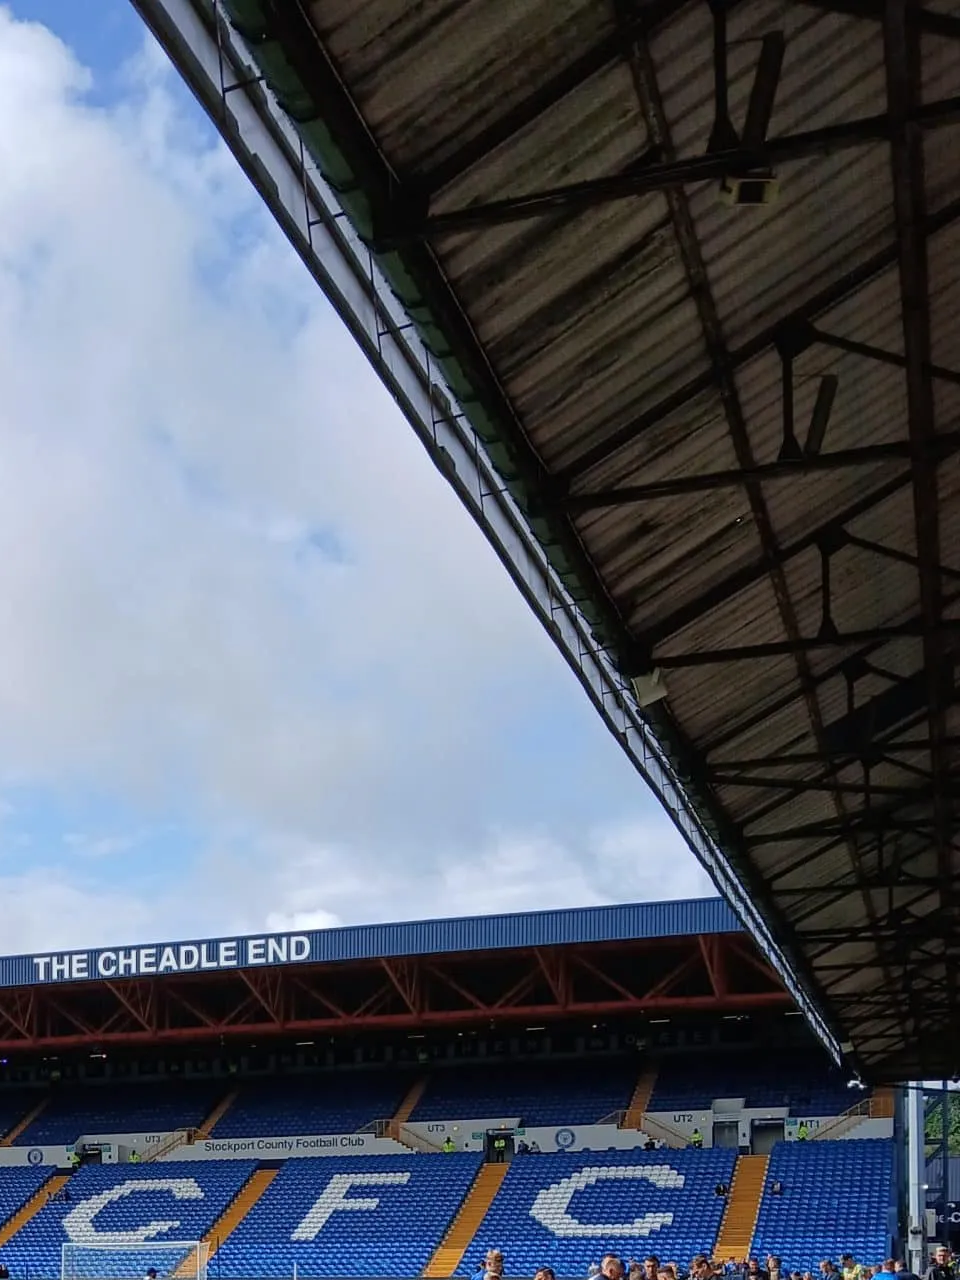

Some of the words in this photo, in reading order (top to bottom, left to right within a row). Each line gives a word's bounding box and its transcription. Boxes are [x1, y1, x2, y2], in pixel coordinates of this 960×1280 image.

[33, 953, 89, 981] THE
[97, 940, 237, 977] CHEADLE
[247, 935, 311, 965] END
[673, 1114, 693, 1123] UT2
[427, 1124, 446, 1133] UT3
[144, 1135, 161, 1144] UT3
[204, 1139, 255, 1153] Stockport
[257, 1139, 294, 1152] County
[296, 1137, 338, 1149] Football
[340, 1136, 365, 1147] Club
